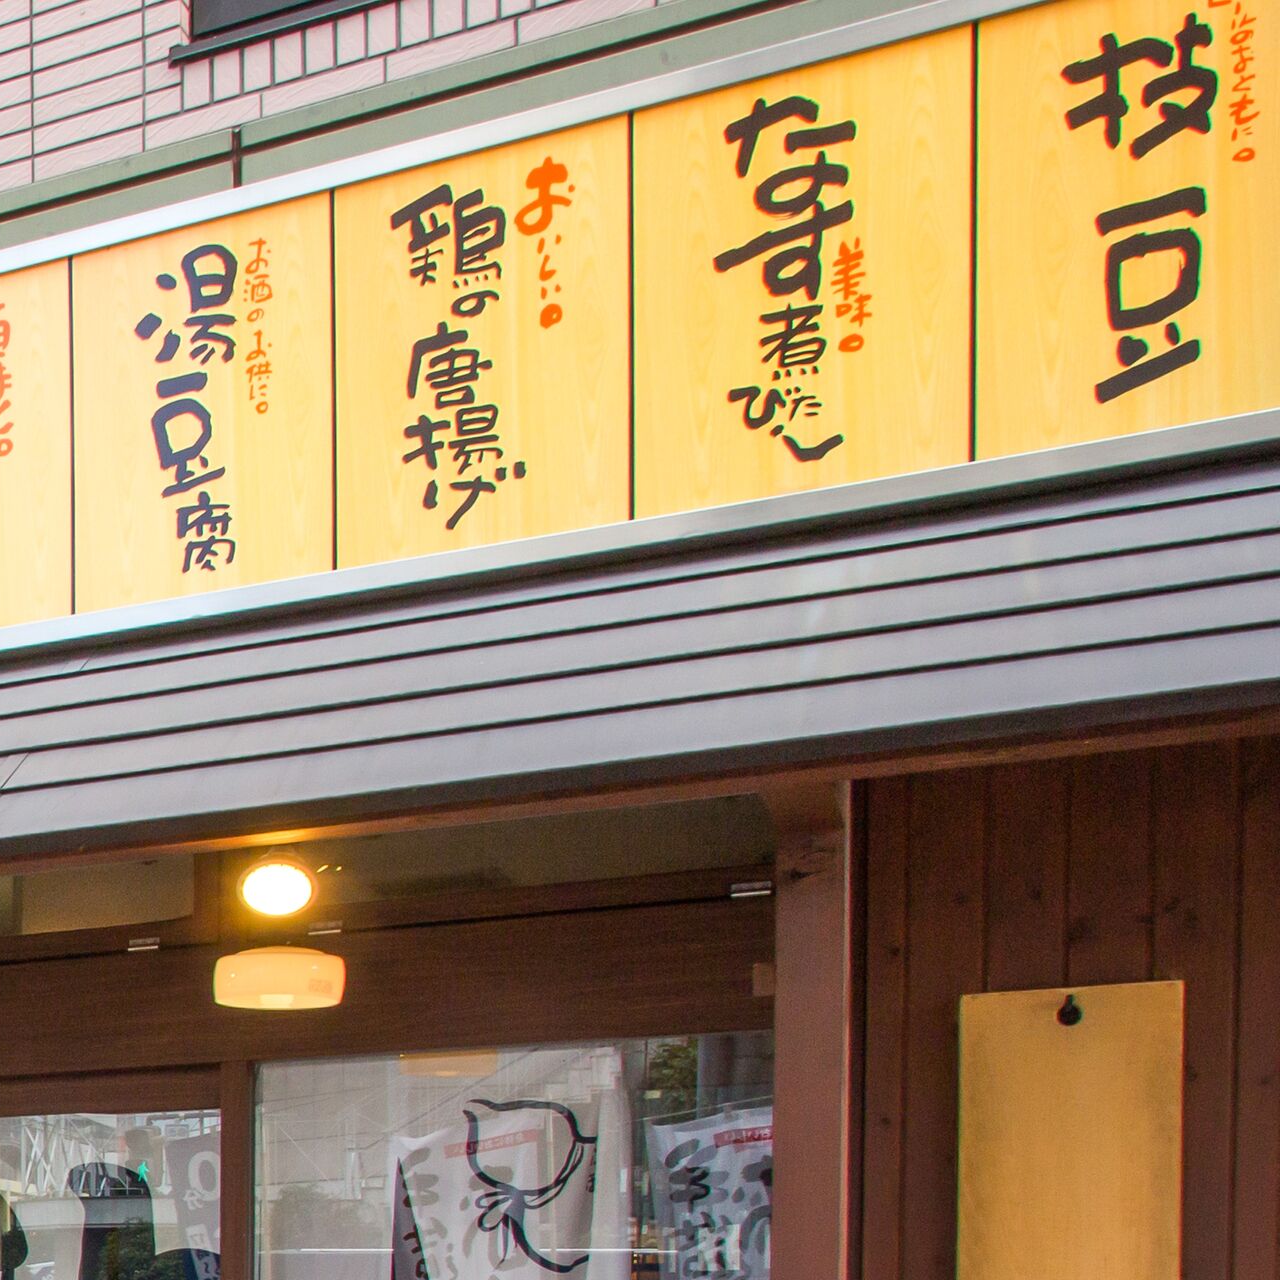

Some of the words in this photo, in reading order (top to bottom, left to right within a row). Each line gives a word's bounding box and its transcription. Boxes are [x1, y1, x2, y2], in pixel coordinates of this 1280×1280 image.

[1208, 0, 1261, 163] ールのおともに。
[134, 242, 240, 575] 湯豆腐
[389, 183, 528, 531] 鶏の唐揚げ
[713, 95, 859, 463] なす煮びたし
